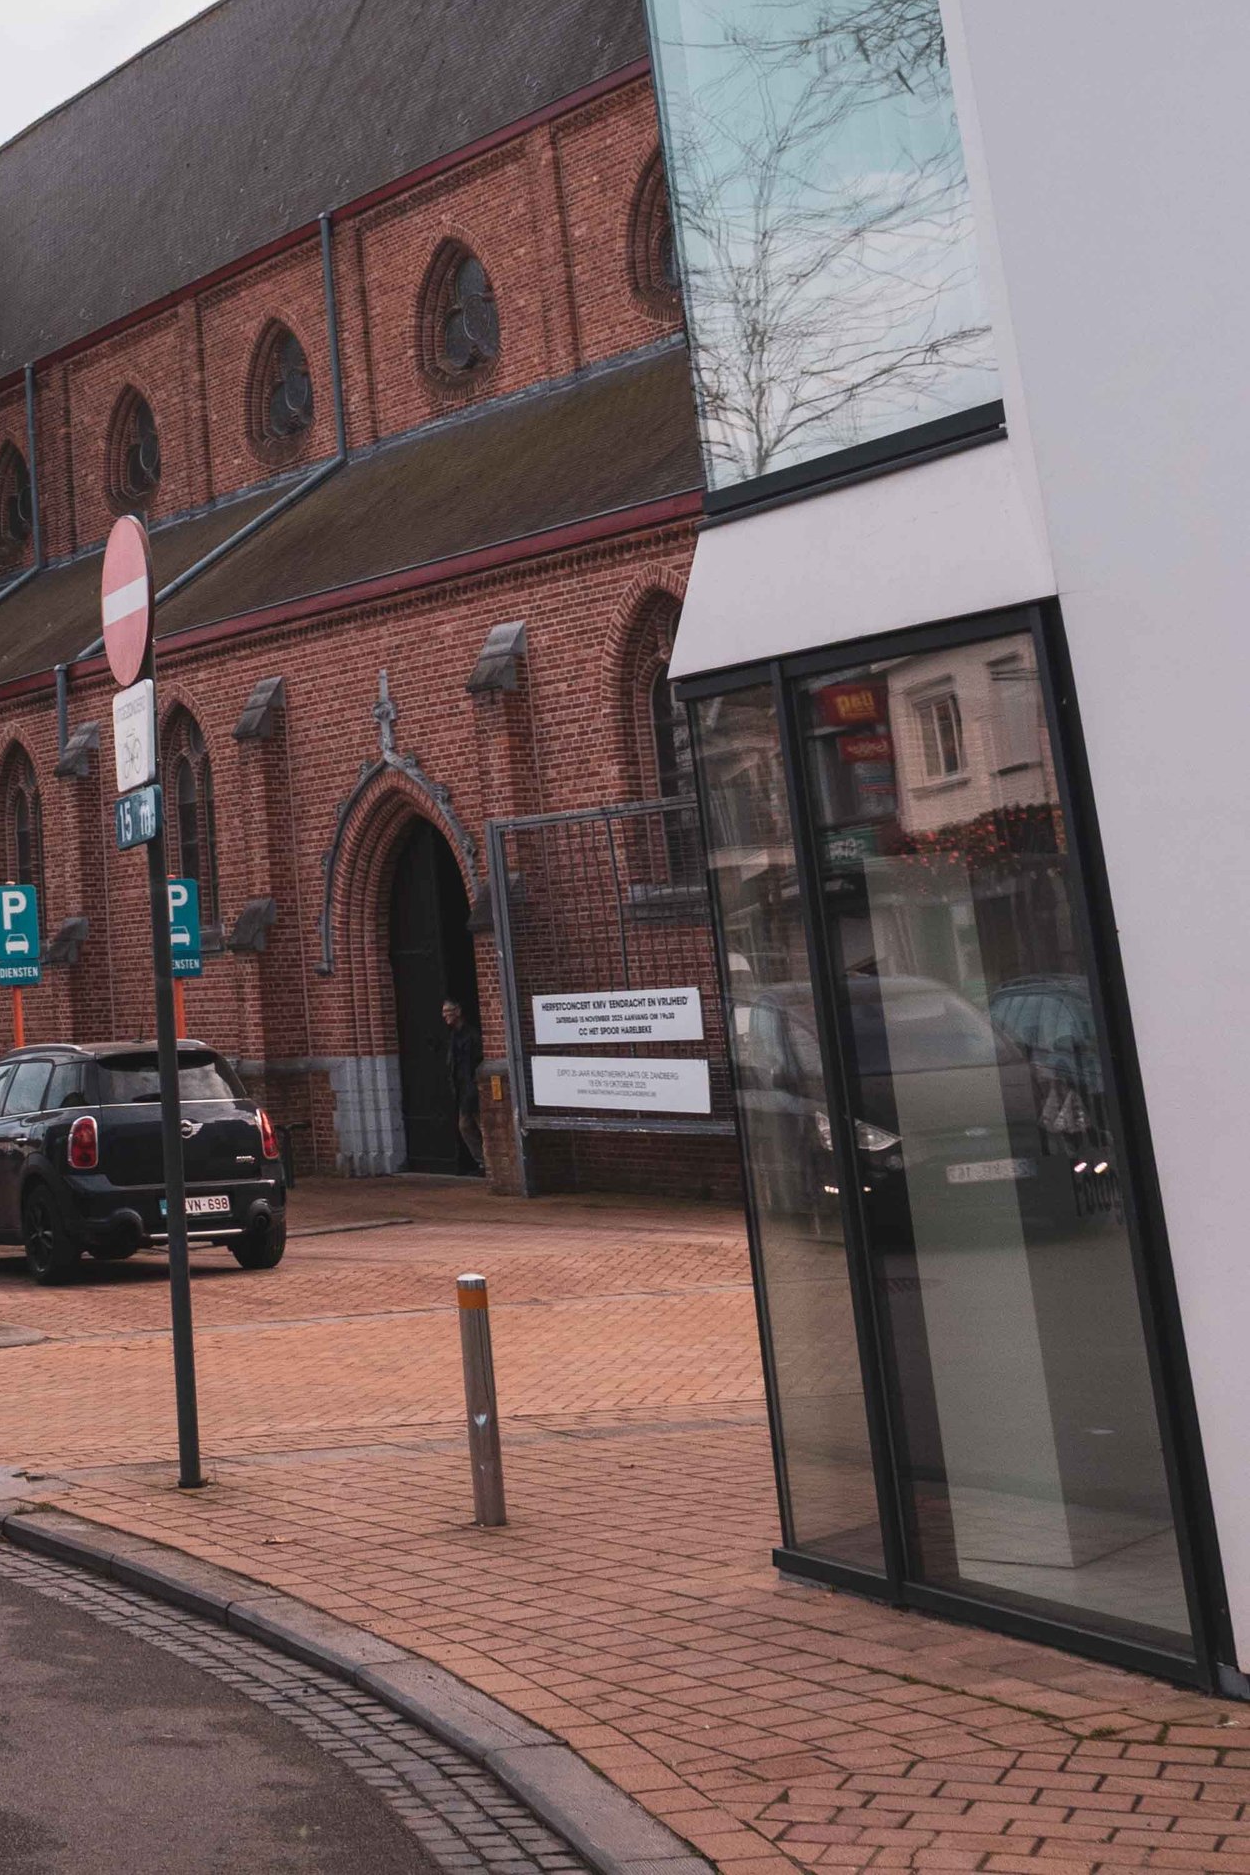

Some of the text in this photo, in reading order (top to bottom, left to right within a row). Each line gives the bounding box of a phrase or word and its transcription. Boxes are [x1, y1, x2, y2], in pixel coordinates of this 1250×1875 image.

[119, 800, 133, 843] 15
[2, 891, 27, 930] P
[168, 885, 188, 922] P
[172, 959, 200, 970] ENSTEN
[0, 966, 39, 979] DIENSTEN
[542, 1000, 591, 1011] HERFSTCONCERT
[648, 997, 656, 1007] EN
[585, 1014, 610, 1023] NOVEMBER
[589, 1027, 598, 1036] HET
[600, 1026, 619, 1035] SPOOR
[621, 1025, 652, 1034] HARELBEKE
[187, 1197, 229, 1212] VN-698
